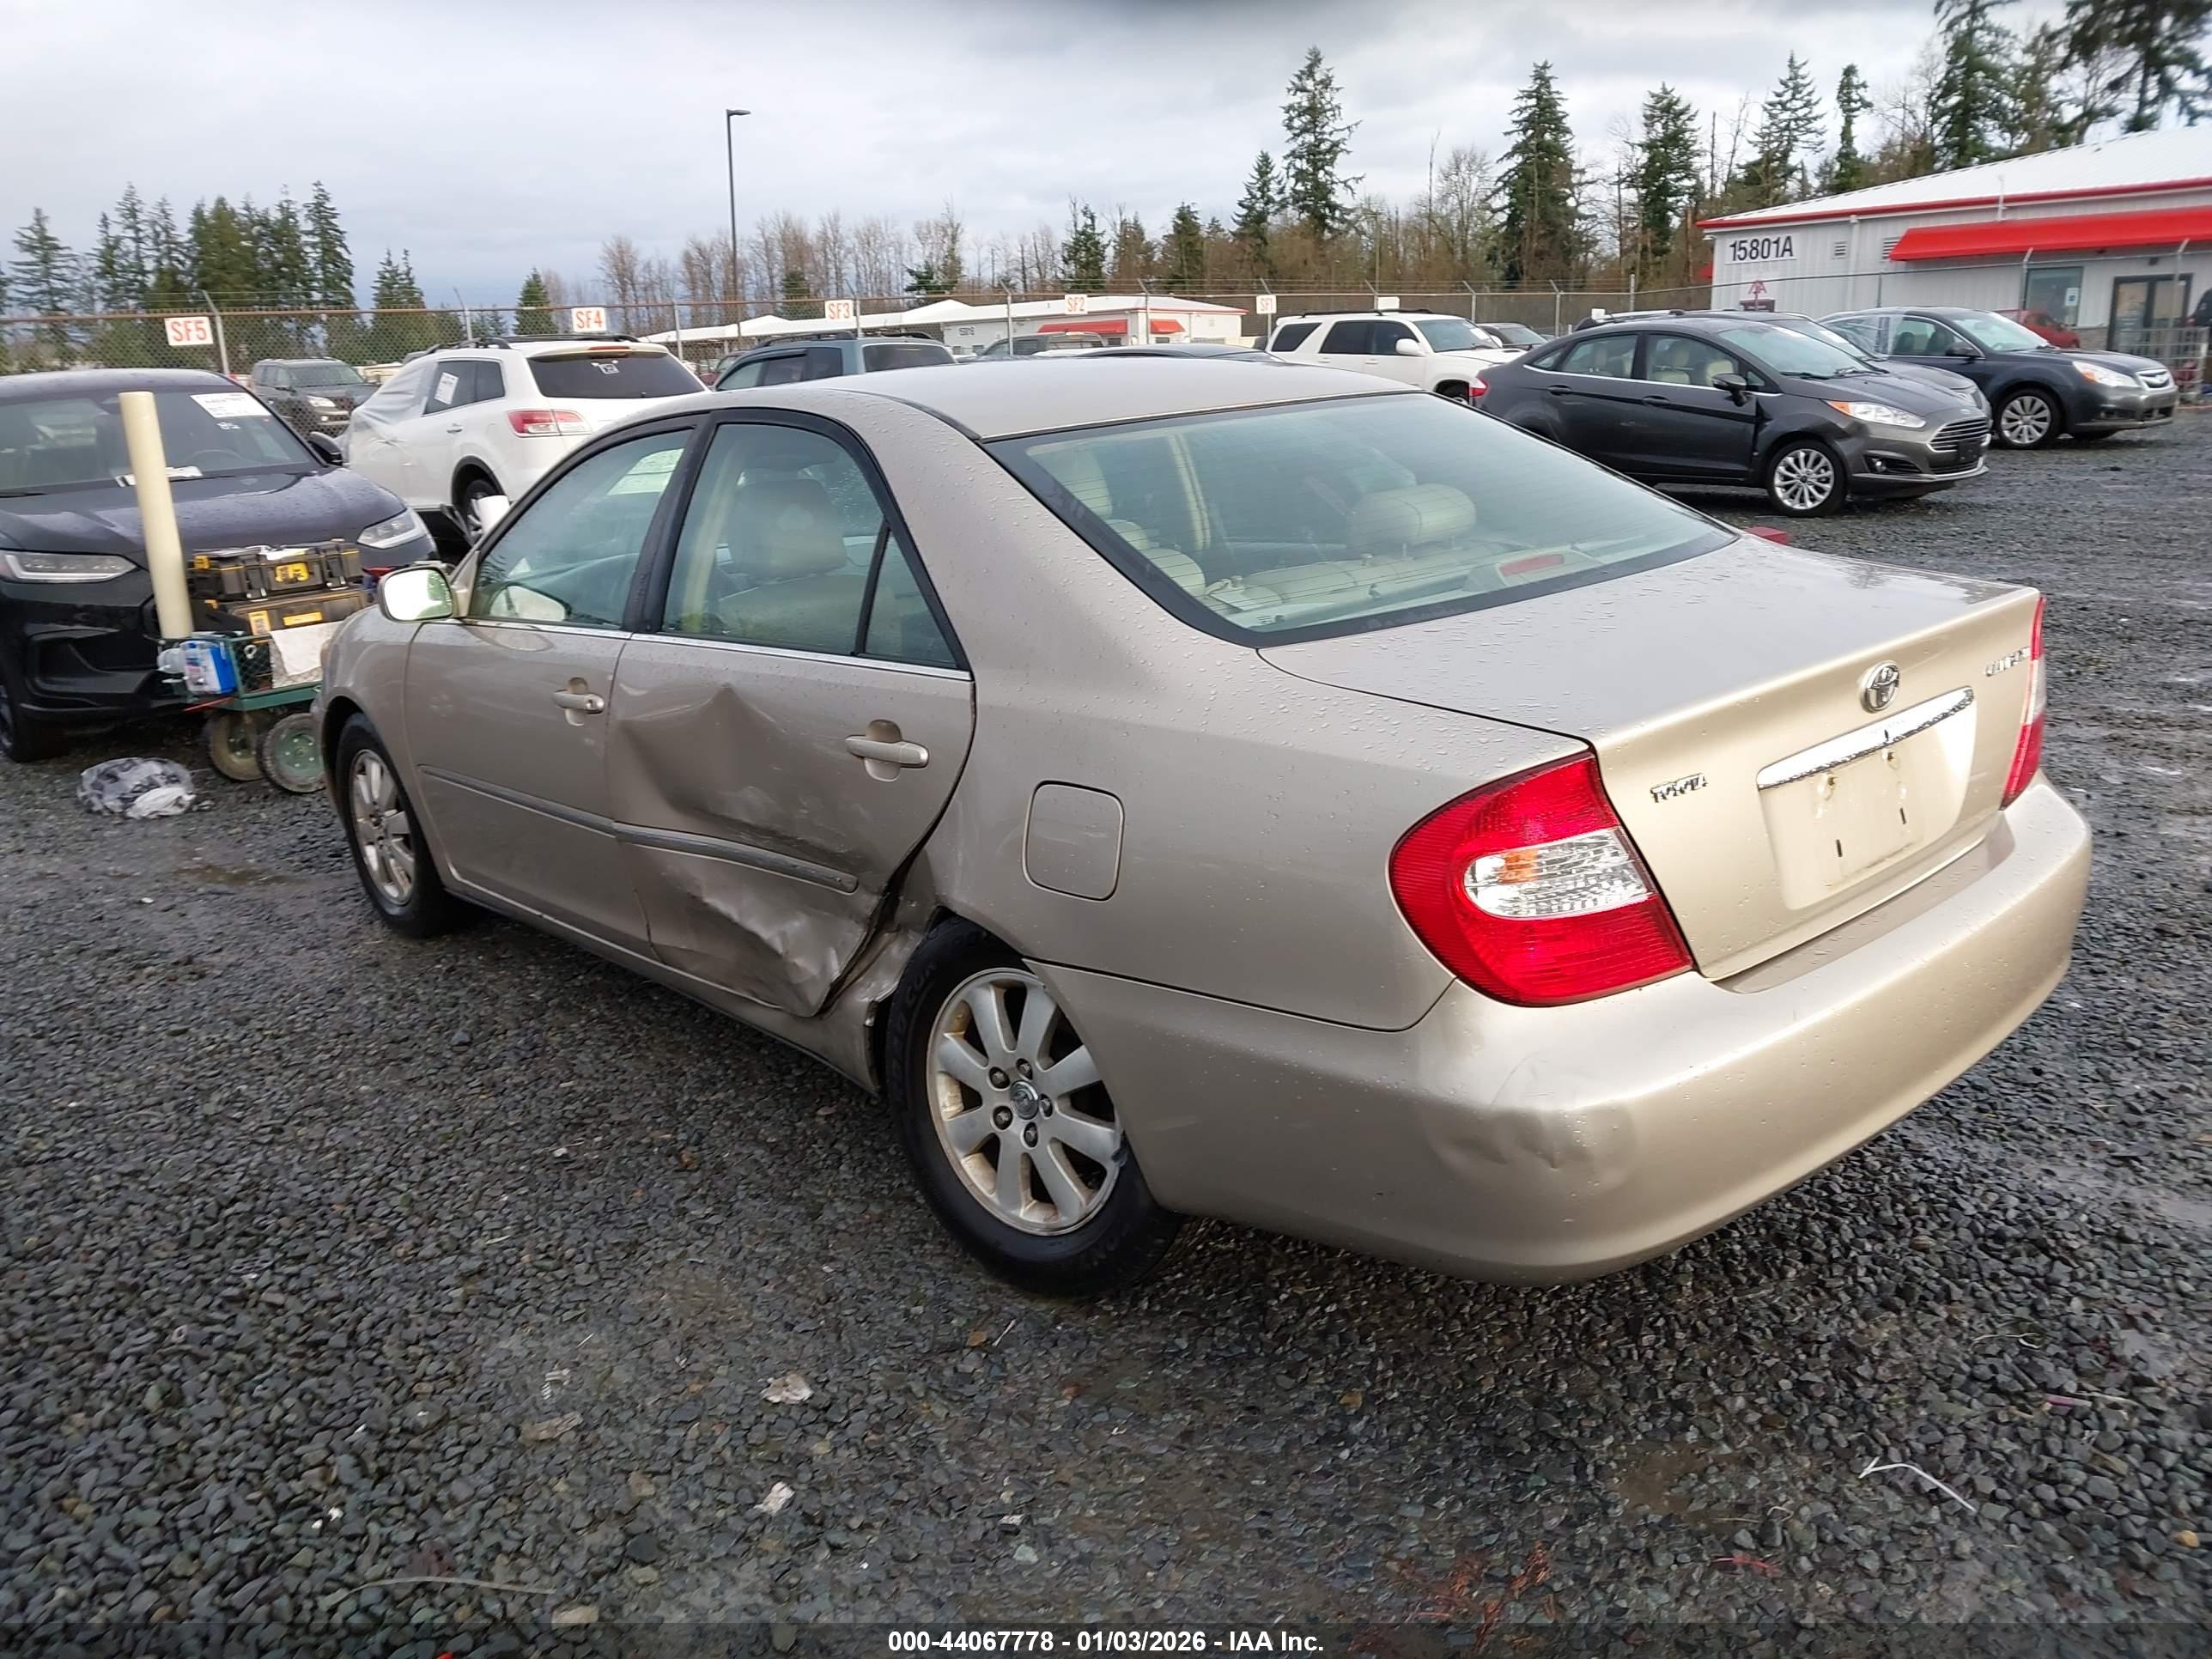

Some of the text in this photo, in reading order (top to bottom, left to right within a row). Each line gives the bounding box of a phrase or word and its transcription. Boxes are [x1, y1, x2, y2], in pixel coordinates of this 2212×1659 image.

[1729, 235, 1794, 262] 15801A
[828, 302, 850, 319] SF3
[1067, 296, 1085, 312] SF2
[576, 310, 603, 329] SF4
[171, 320, 207, 342] SF5
